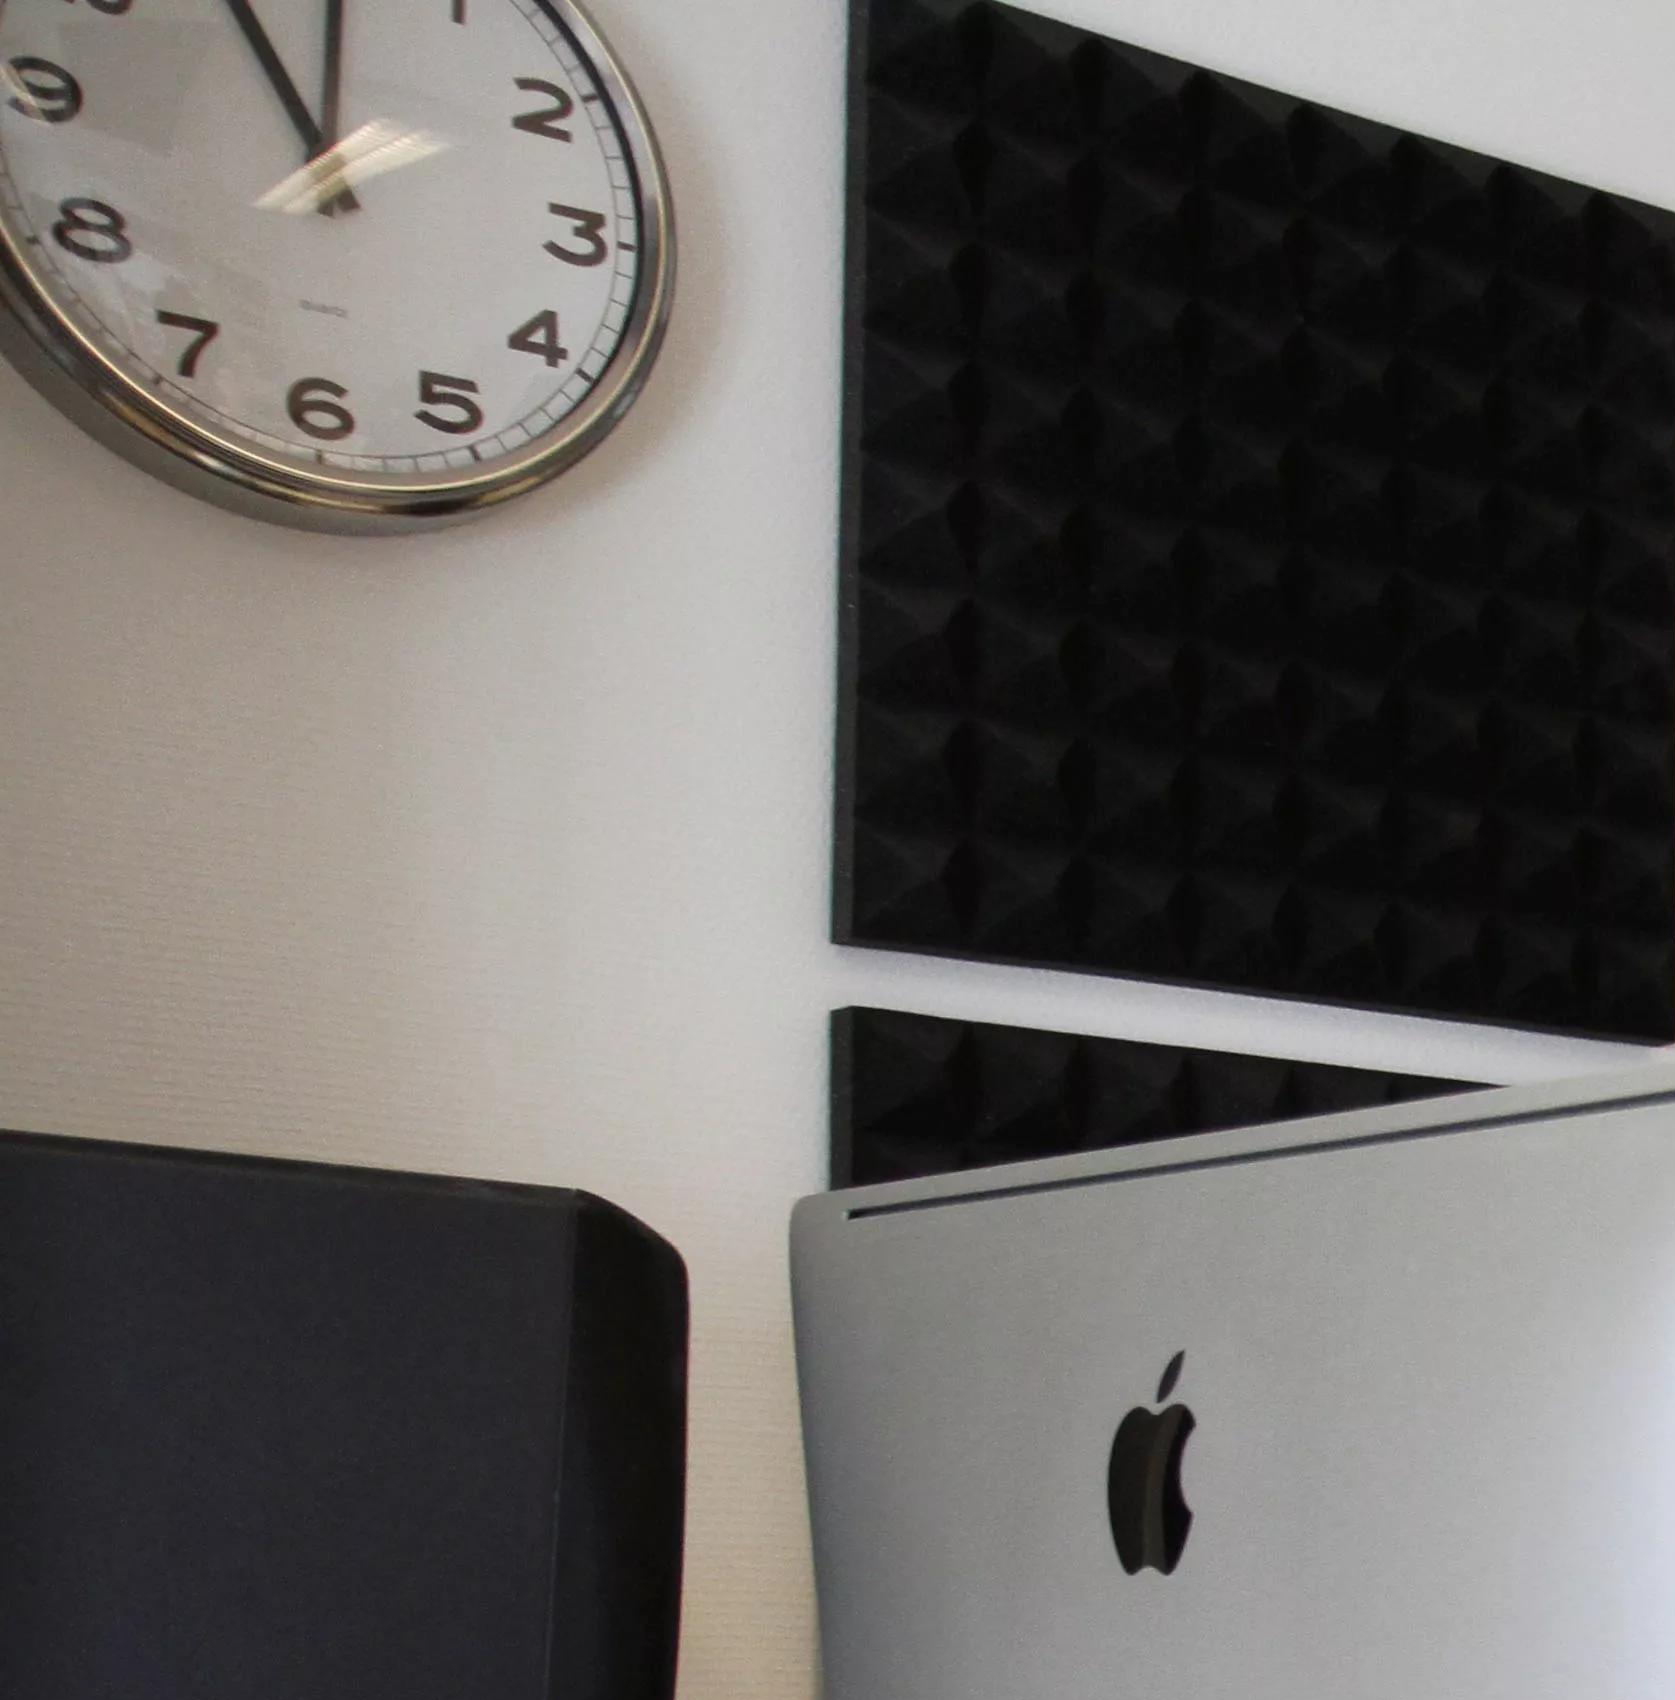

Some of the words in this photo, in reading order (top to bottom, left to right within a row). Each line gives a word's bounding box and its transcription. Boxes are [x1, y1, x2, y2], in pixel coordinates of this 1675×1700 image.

[5, 56, 83, 123] 9
[511, 76, 574, 144] 2
[53, 197, 132, 263] 8
[542, 201, 608, 268] 3
[155, 309, 221, 378] 7
[507, 309, 569, 368] 4
[286, 377, 355, 441] 6
[412, 370, 485, 435] 5
